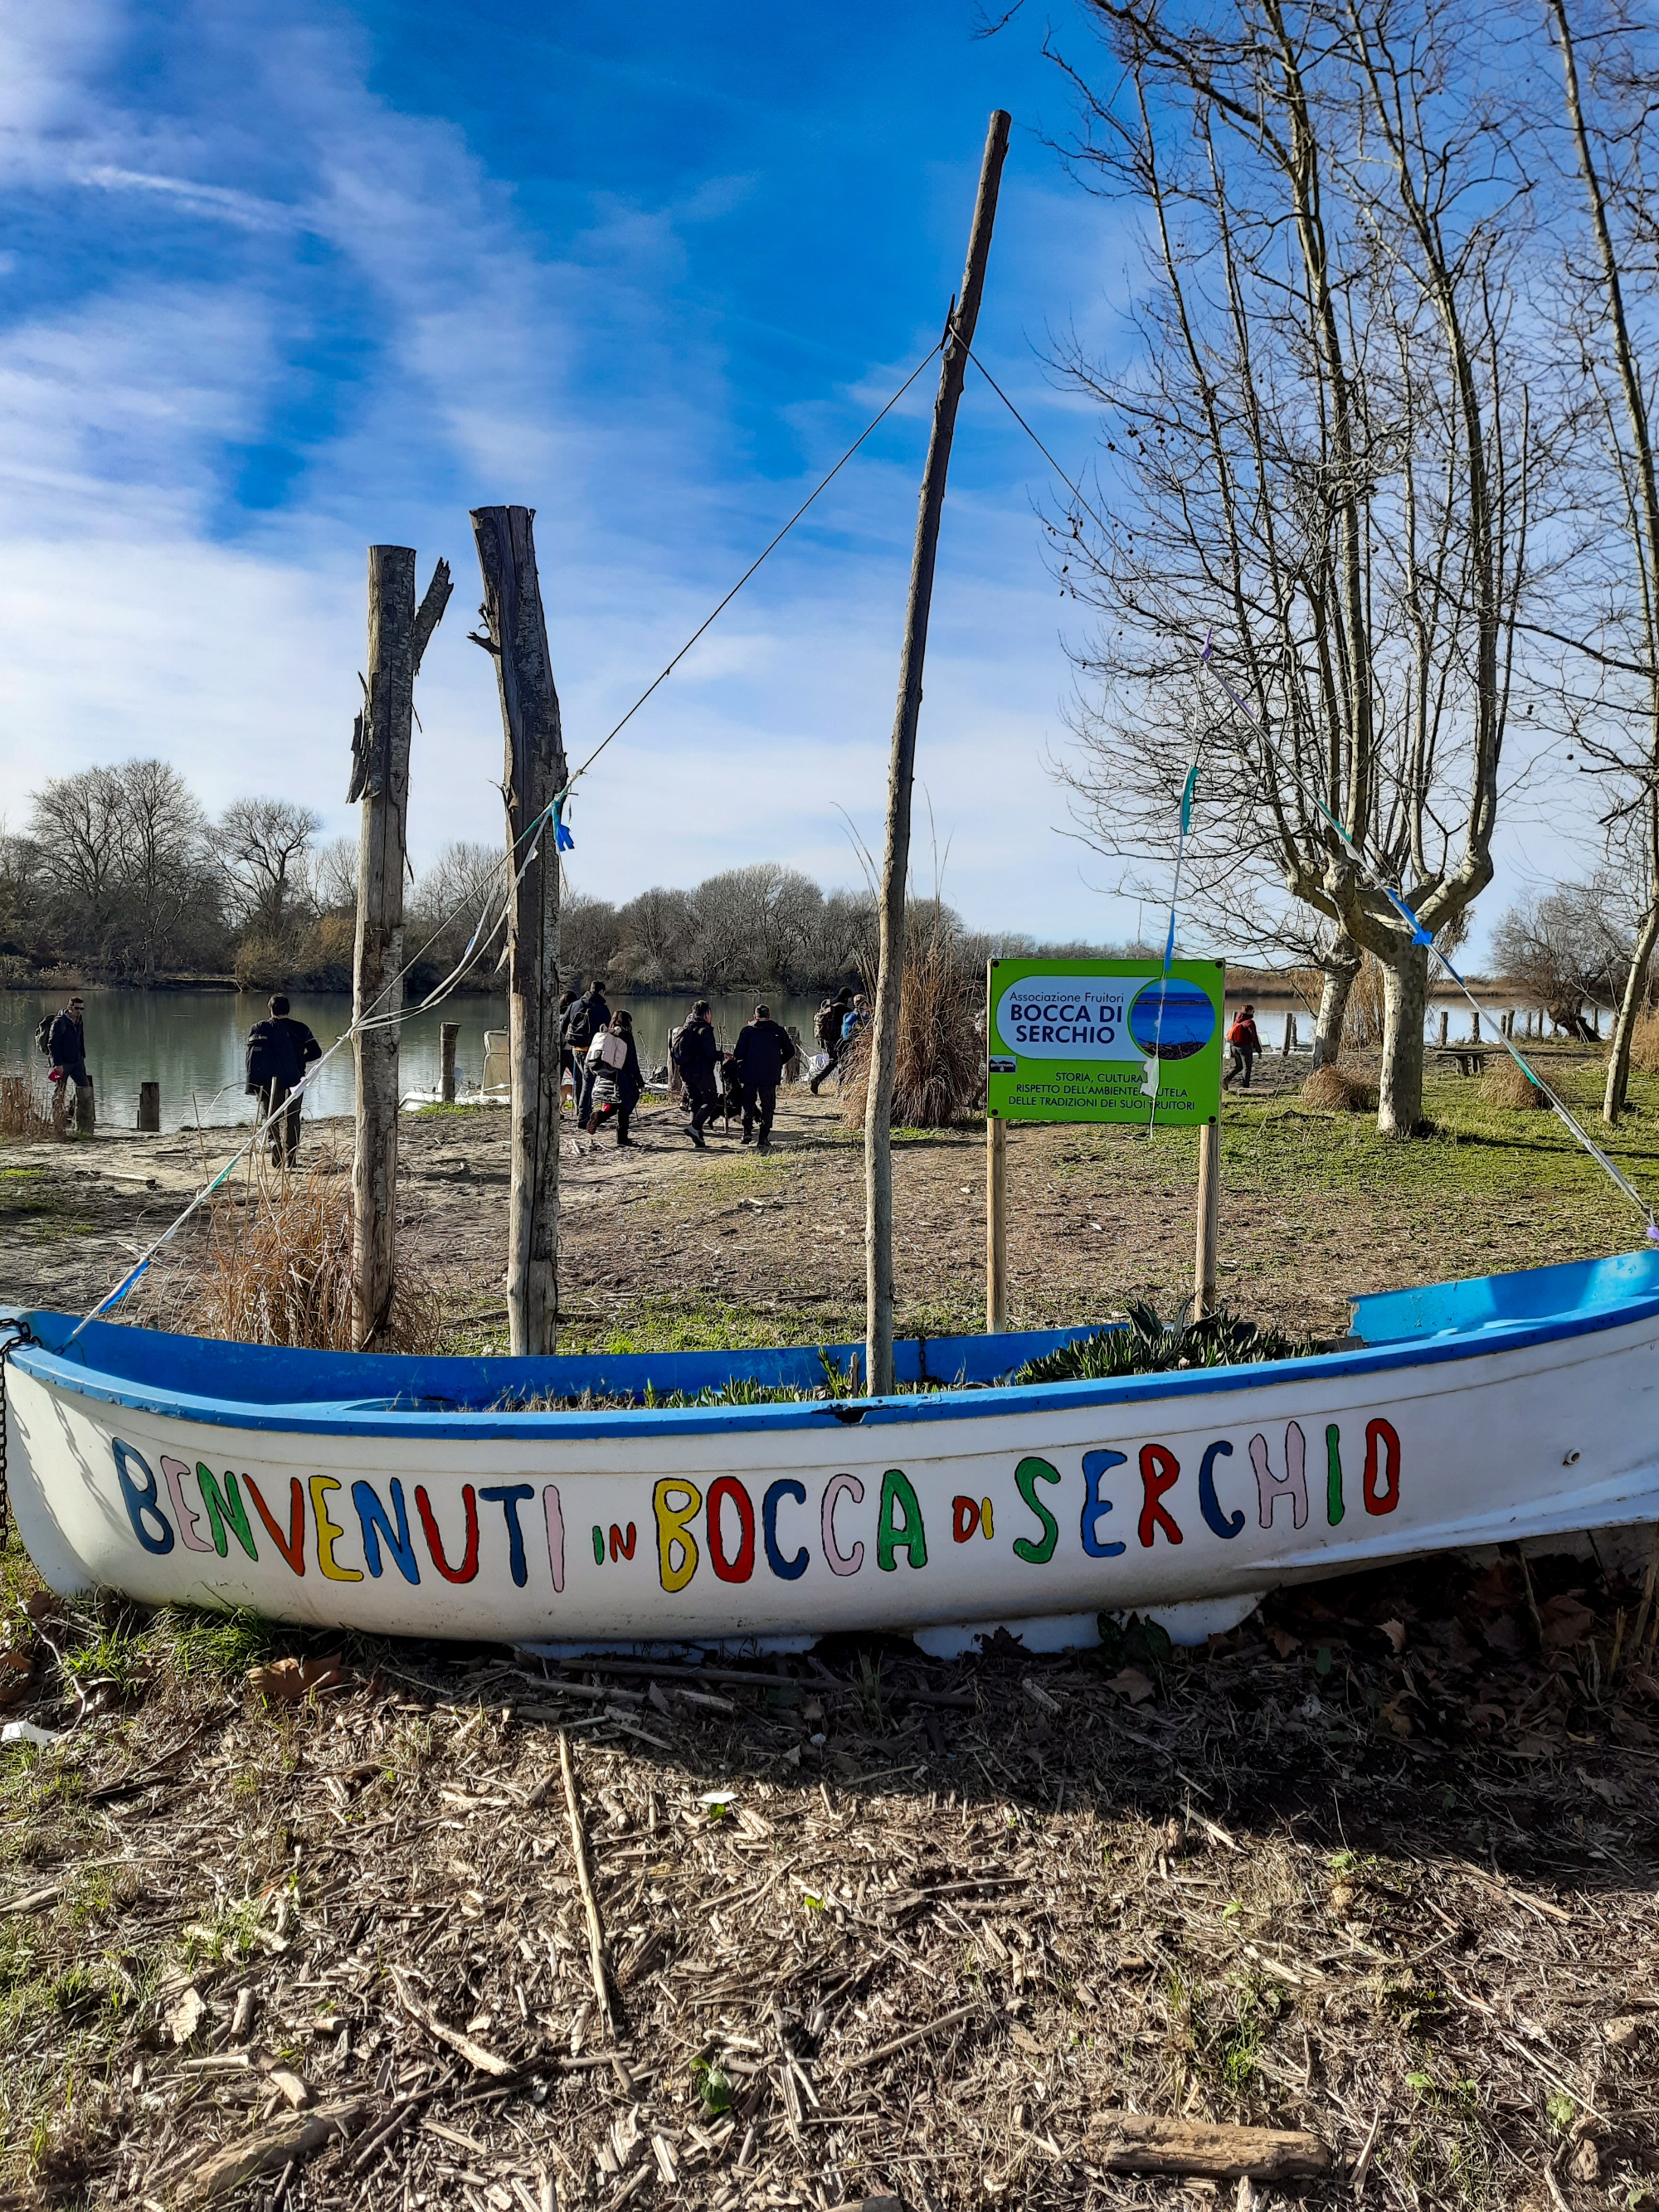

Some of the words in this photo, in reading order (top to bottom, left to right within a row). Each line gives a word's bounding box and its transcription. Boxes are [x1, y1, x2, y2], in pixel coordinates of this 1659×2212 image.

[1010, 991, 1081, 1002] Associazione
[1084, 992, 1124, 1003] Fruitori
[1010, 1004, 1092, 1022] BOCCA
[1099, 1005, 1122, 1023] DI
[1015, 1024, 1115, 1044] SERCHIO
[1055, 1072, 1094, 1083] STORIA,
[1016, 1083, 1060, 1094] RISPETTO
[1063, 1085, 1139, 1096] DELL'AMBIENTE
[1156, 1087, 1188, 1097] UTELA
[1009, 1096, 1037, 1106] DELLE
[1039, 1096, 1097, 1107] TRADIZIONI
[1101, 1099, 1117, 1108] DEI
[1120, 1099, 1146, 1109] SUOI
[111, 1437, 566, 1593] BENVENUTI
[592, 1521, 637, 1565] IN
[652, 1469, 928, 1593] BOCCA
[952, 1495, 995, 1544] DI
[1012, 1417, 1402, 1565] SERCHIO
